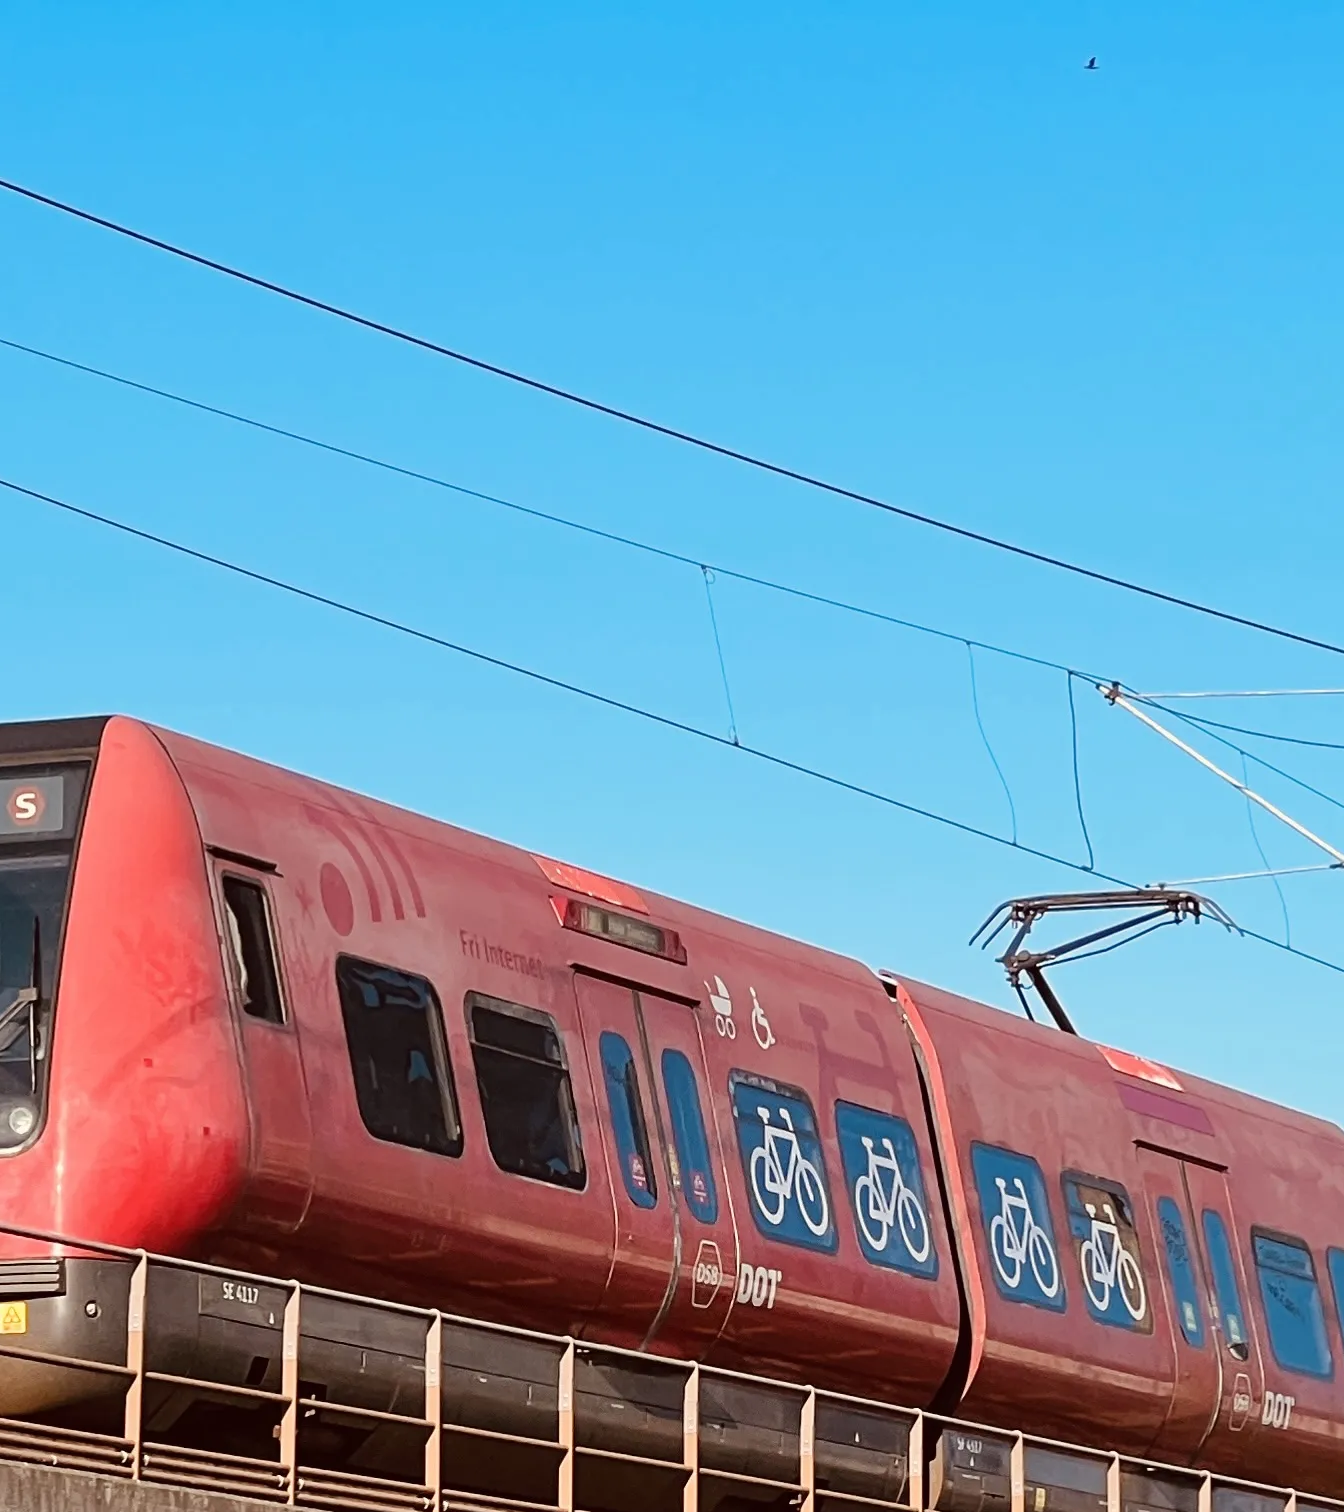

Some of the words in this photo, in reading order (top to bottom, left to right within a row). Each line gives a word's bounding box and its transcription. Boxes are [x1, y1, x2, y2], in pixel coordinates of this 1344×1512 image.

[14, 793, 37, 819] S
[459, 929, 481, 960] Fri
[483, 937, 545, 981] Internet
[696, 1263, 718, 1286] DSB
[222, 1282, 235, 1300] SE
[236, 1285, 259, 1304] 4117
